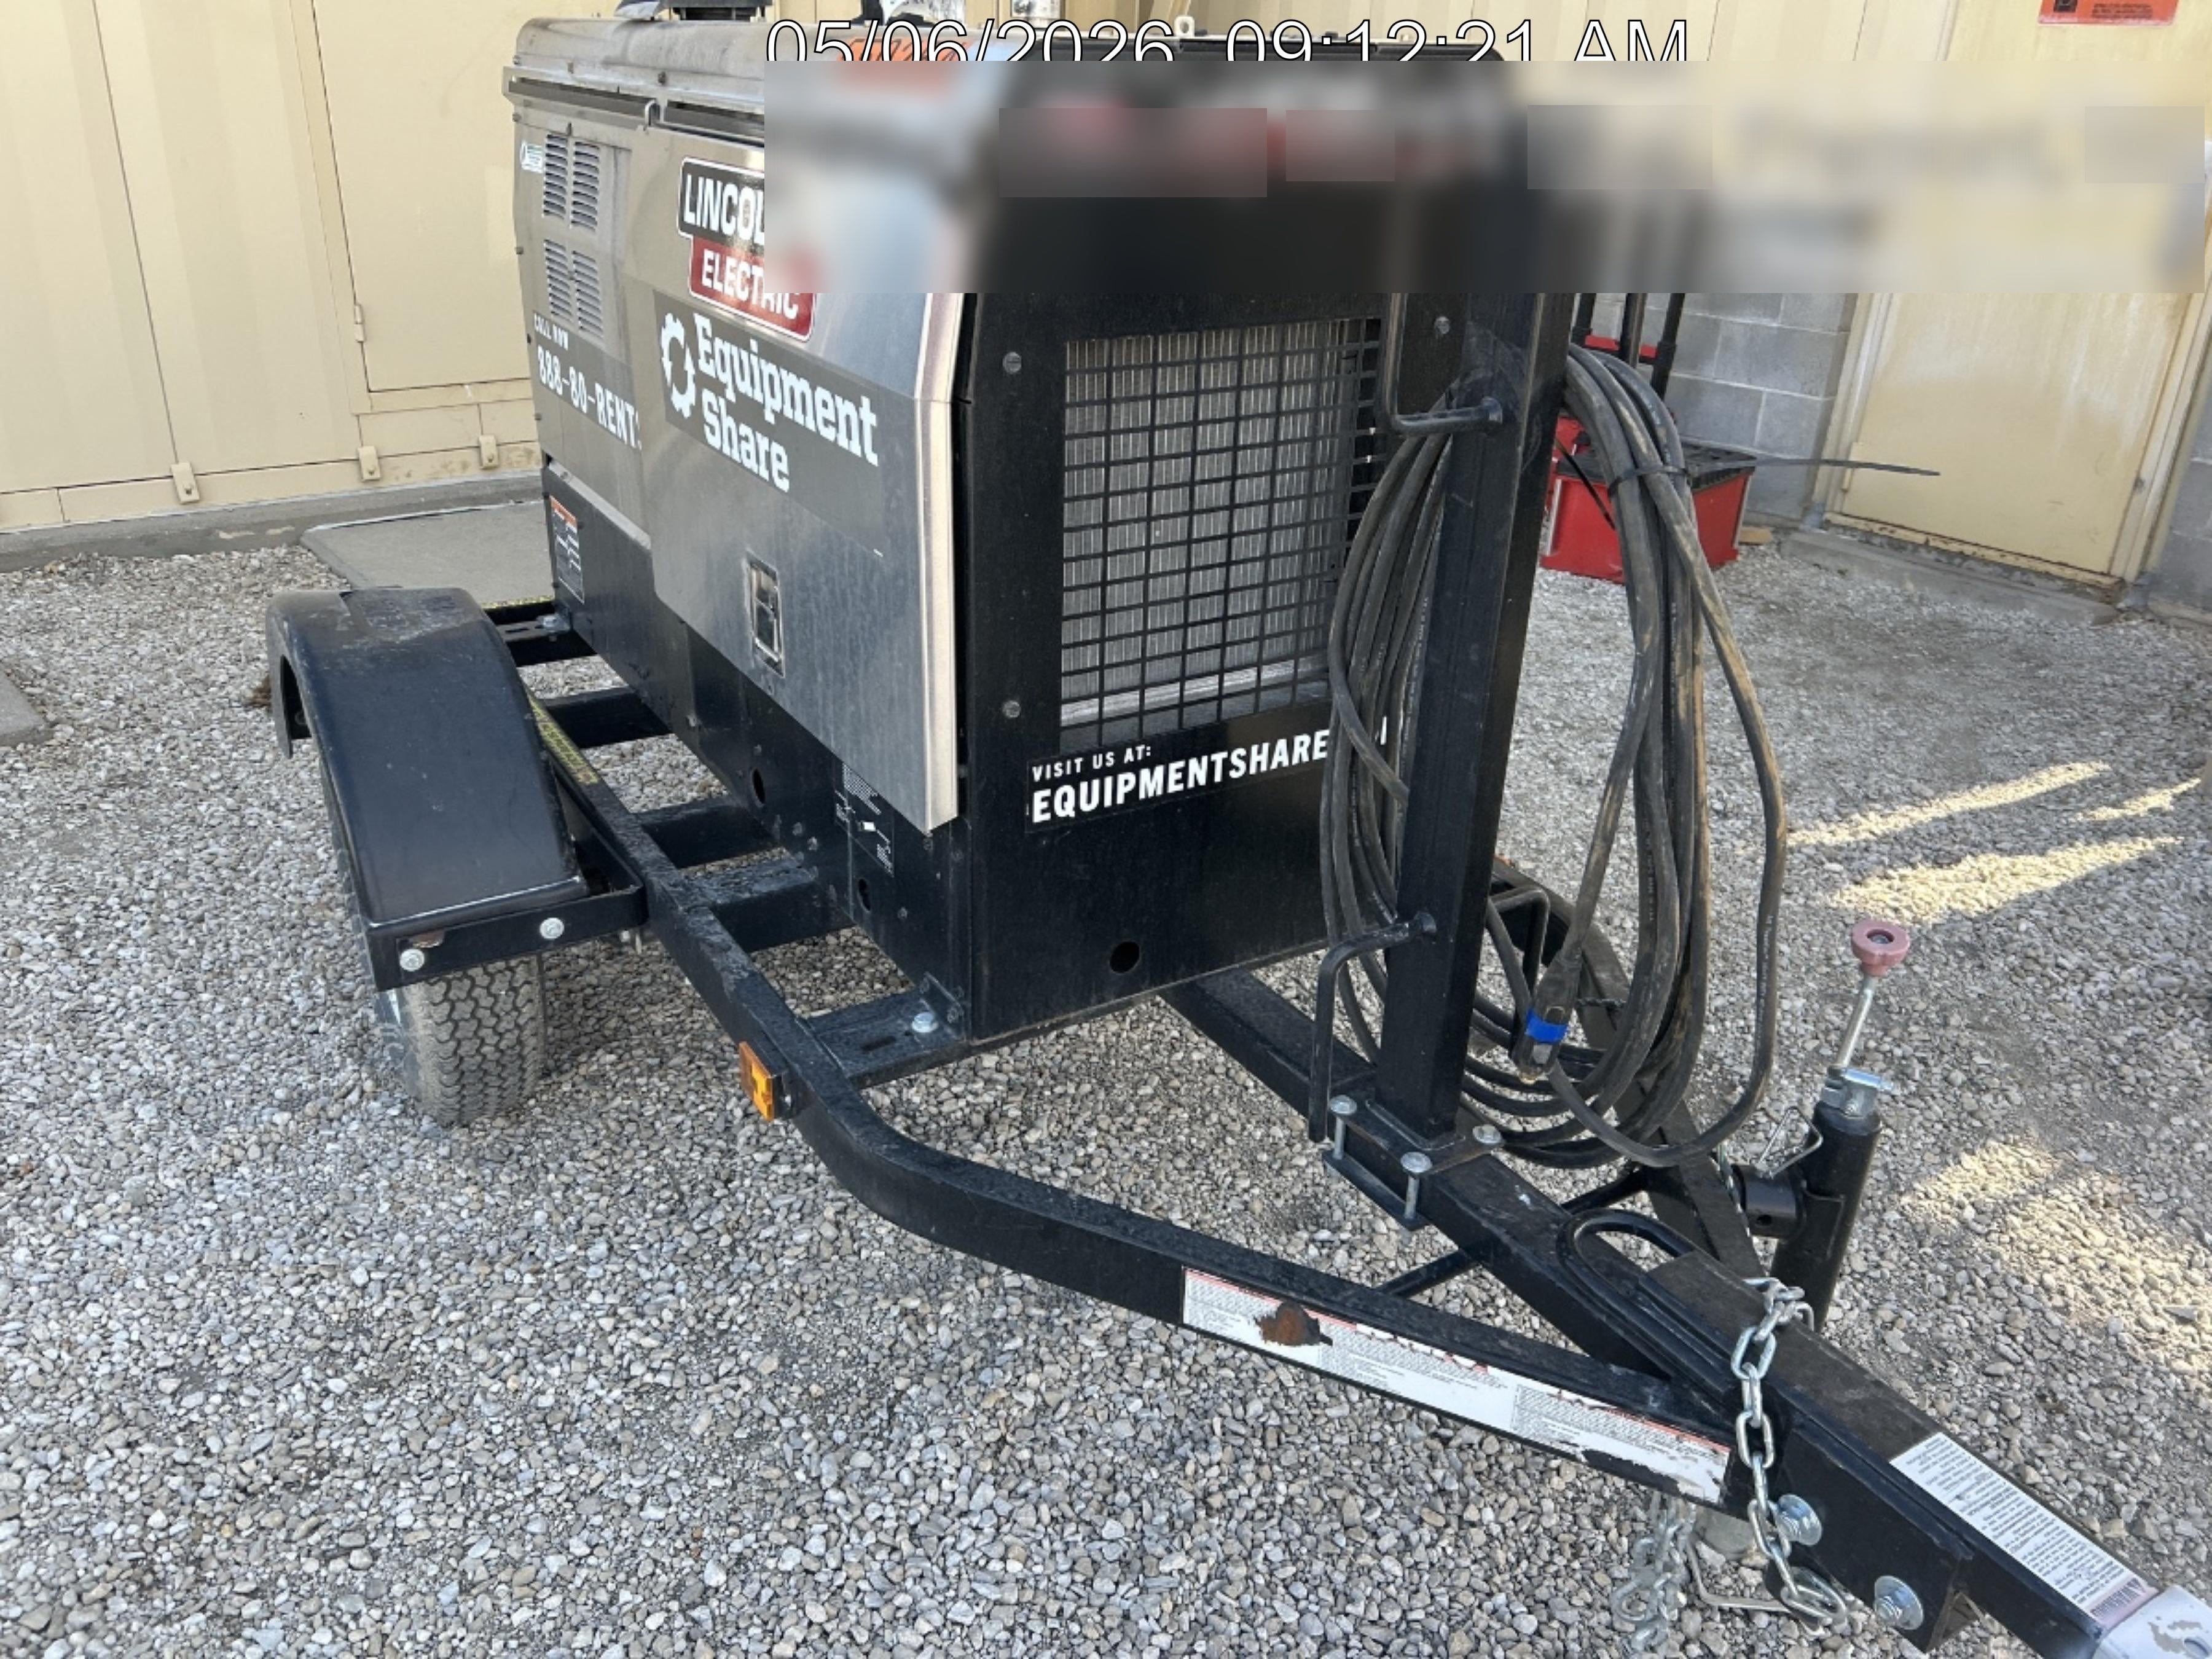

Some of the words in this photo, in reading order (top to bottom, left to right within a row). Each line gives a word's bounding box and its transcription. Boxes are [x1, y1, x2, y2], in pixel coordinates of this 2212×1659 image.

[683, 175, 764, 245] LINCOL
[693, 312, 879, 467] Equipment
[702, 388, 790, 492] Share
[1032, 757, 1083, 782] VISIT
[1092, 750, 1115, 771] US
[1124, 743, 1152, 762] AT:
[1032, 716, 1387, 823] EQUIPMENTSHARE
